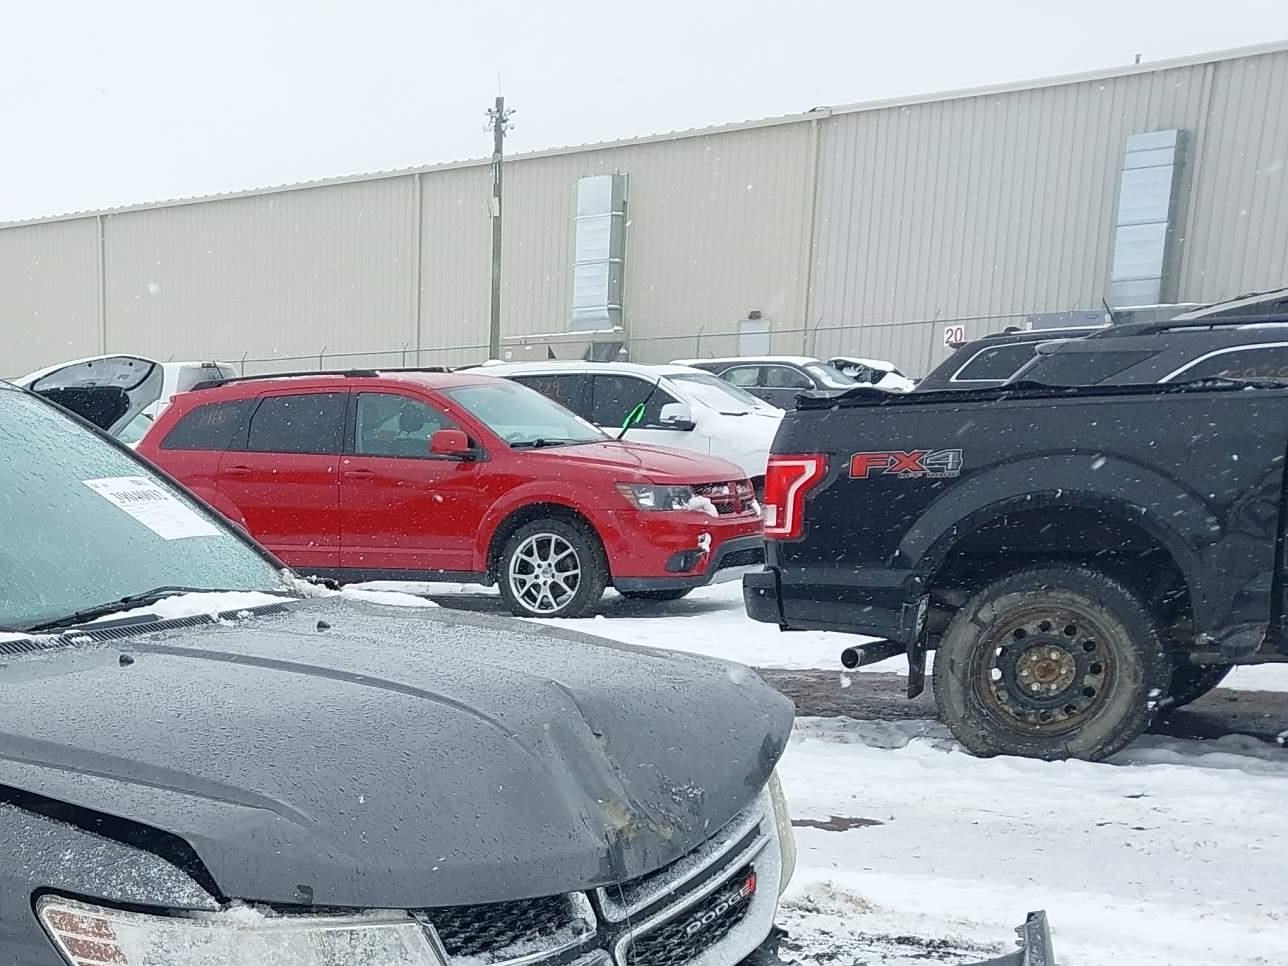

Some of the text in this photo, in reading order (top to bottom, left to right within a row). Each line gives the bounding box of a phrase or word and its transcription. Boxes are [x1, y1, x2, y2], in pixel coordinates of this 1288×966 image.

[944, 327, 963, 344] 20
[849, 448, 963, 479] FX4
[686, 882, 753, 938] DODGE
